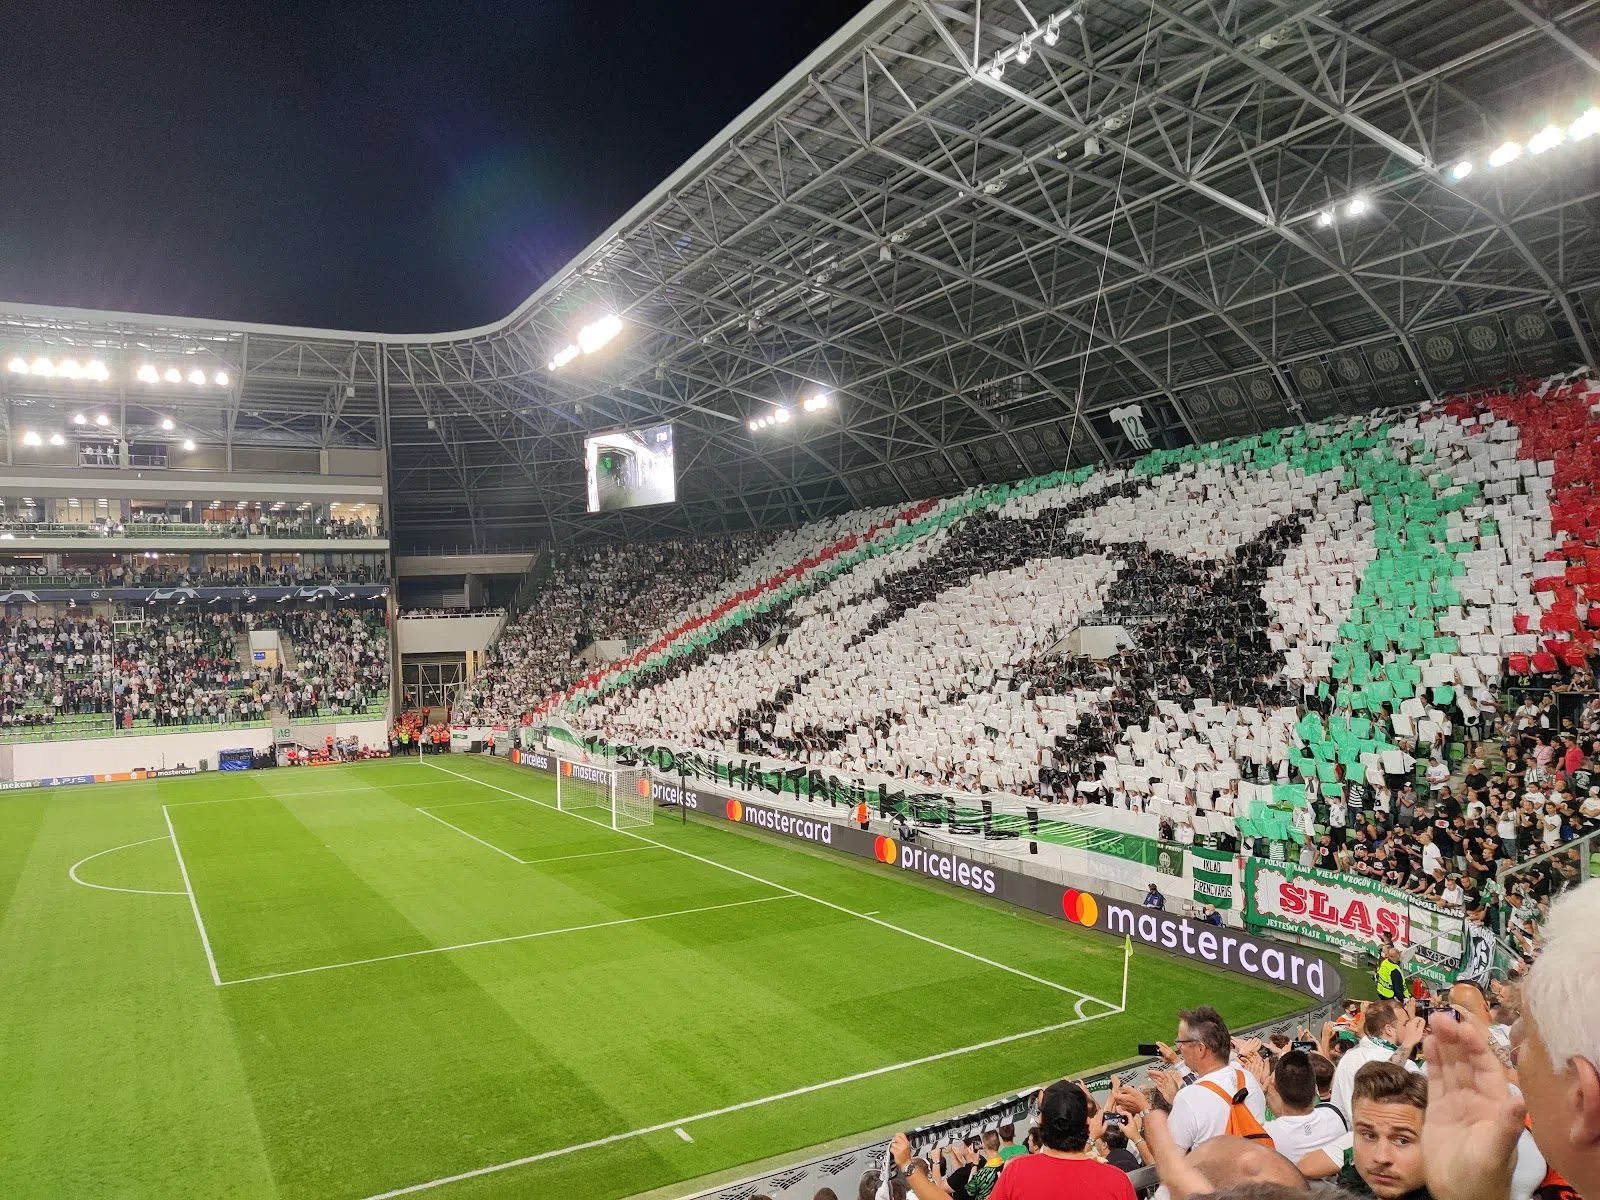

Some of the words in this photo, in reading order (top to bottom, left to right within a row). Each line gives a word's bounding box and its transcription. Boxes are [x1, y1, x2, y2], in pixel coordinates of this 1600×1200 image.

[1121, 415, 1145, 439] 12
[157, 767, 196, 777] mastercard
[520, 752, 548, 770] priceless
[572, 765, 616, 786] mastercar
[652, 782, 698, 809] priceless
[745, 805, 832, 844] mastercard
[901, 845, 996, 894] priceless
[1408, 894, 1465, 918] HOOLIGANS
[1107, 904, 1325, 998] mastercard
